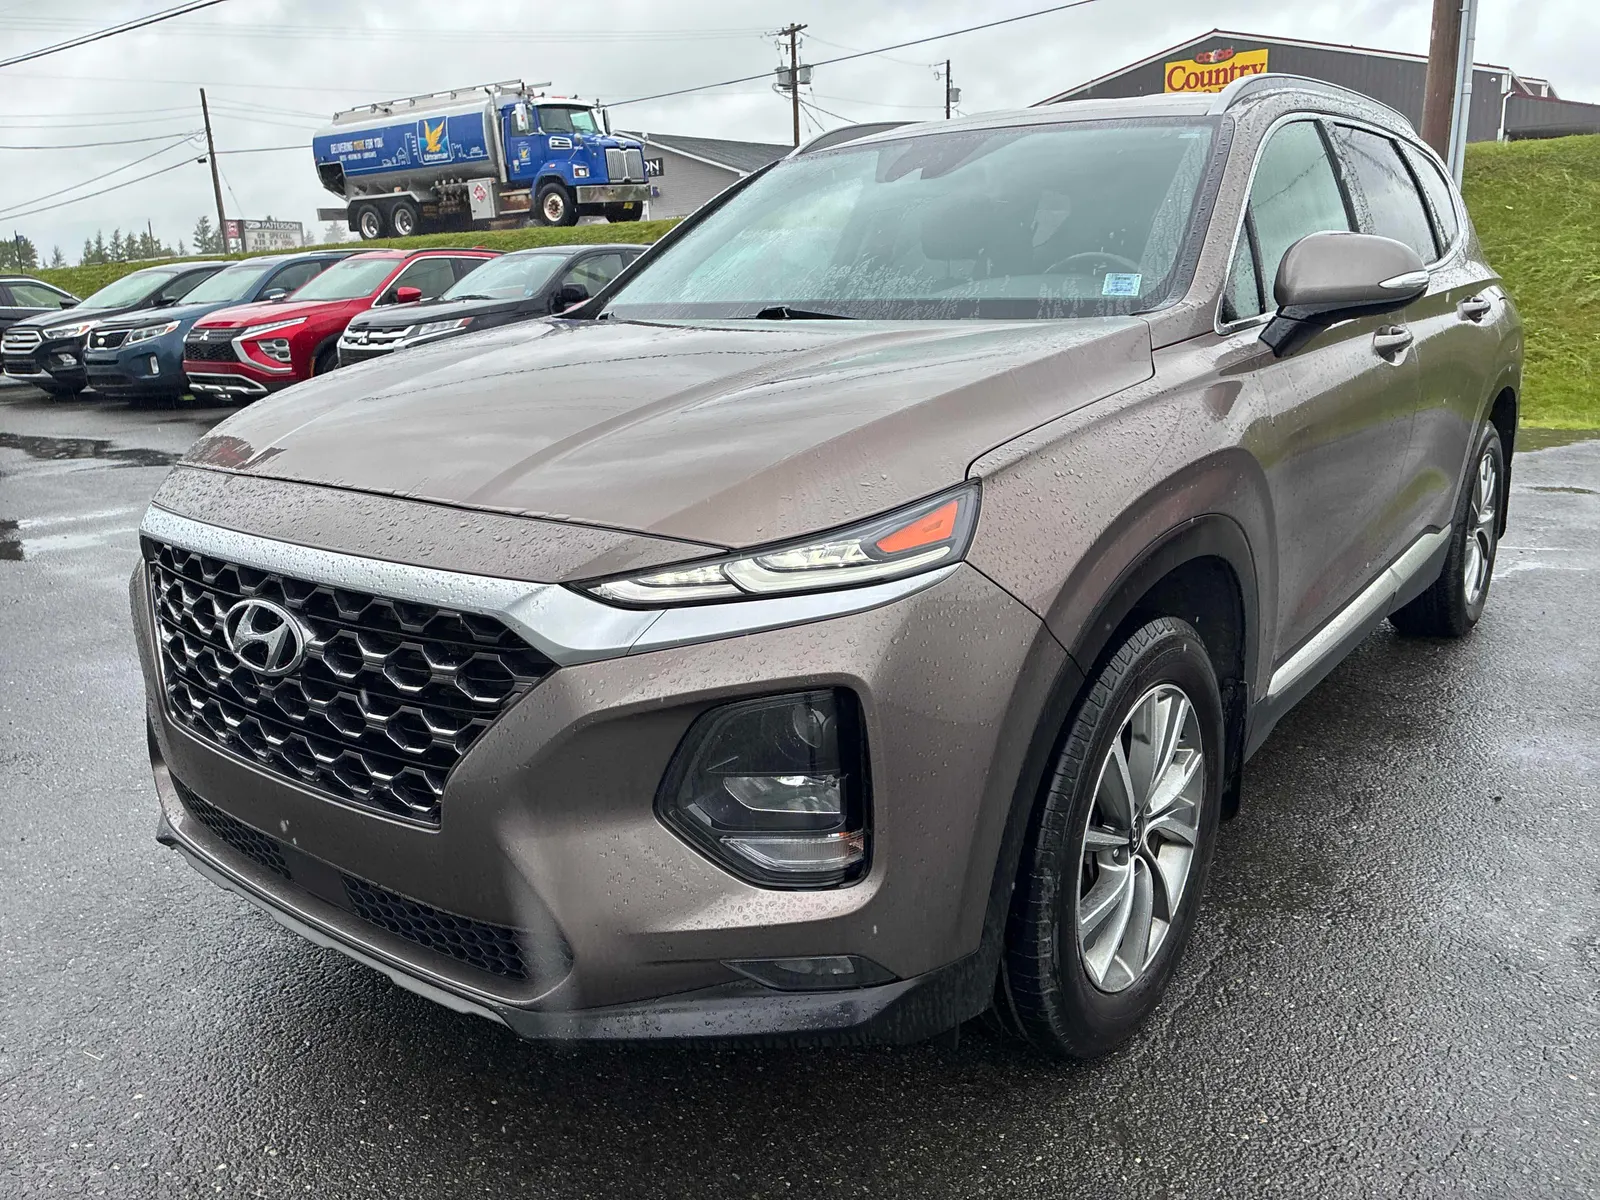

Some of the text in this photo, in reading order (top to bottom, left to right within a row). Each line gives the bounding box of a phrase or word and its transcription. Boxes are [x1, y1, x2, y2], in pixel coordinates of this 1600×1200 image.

[1167, 62, 1265, 92] Country
[365, 138, 374, 150] FOR
[261, 221, 299, 230] PATTERSON
